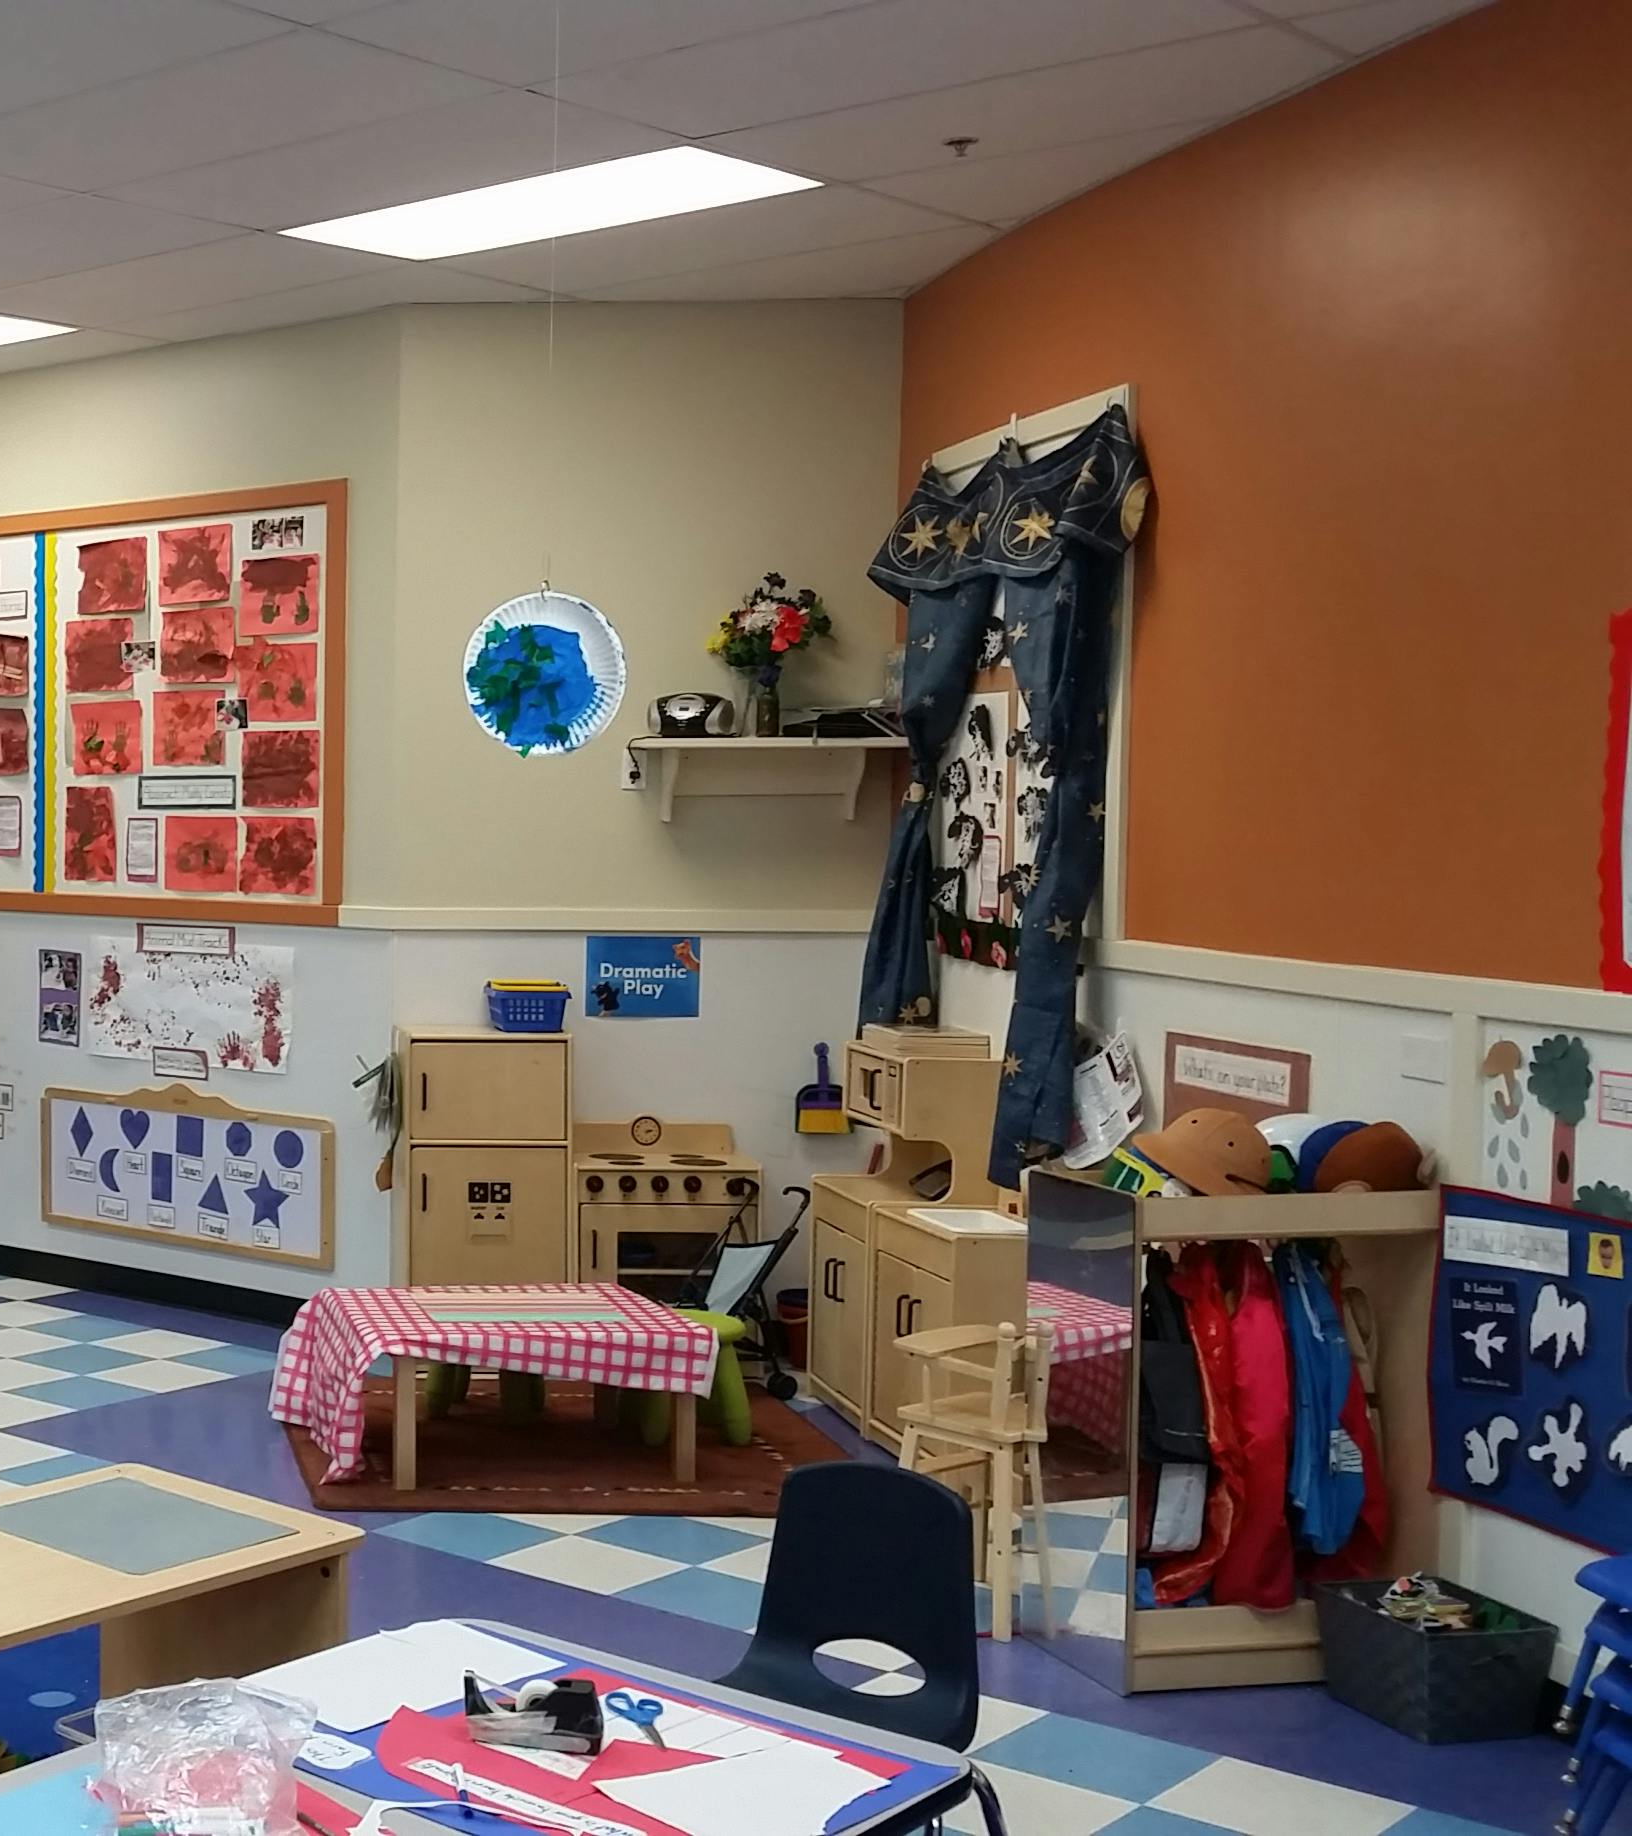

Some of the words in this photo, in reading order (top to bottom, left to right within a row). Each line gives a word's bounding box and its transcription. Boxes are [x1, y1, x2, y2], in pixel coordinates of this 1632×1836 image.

[599, 962, 688, 979] Dramatic
[623, 979, 665, 1000] Play
[1463, 1281, 1472, 1293] It
[1473, 1282, 1504, 1296] Looked
[1452, 1297, 1472, 1310] Like
[1495, 1302, 1516, 1315] Milk
